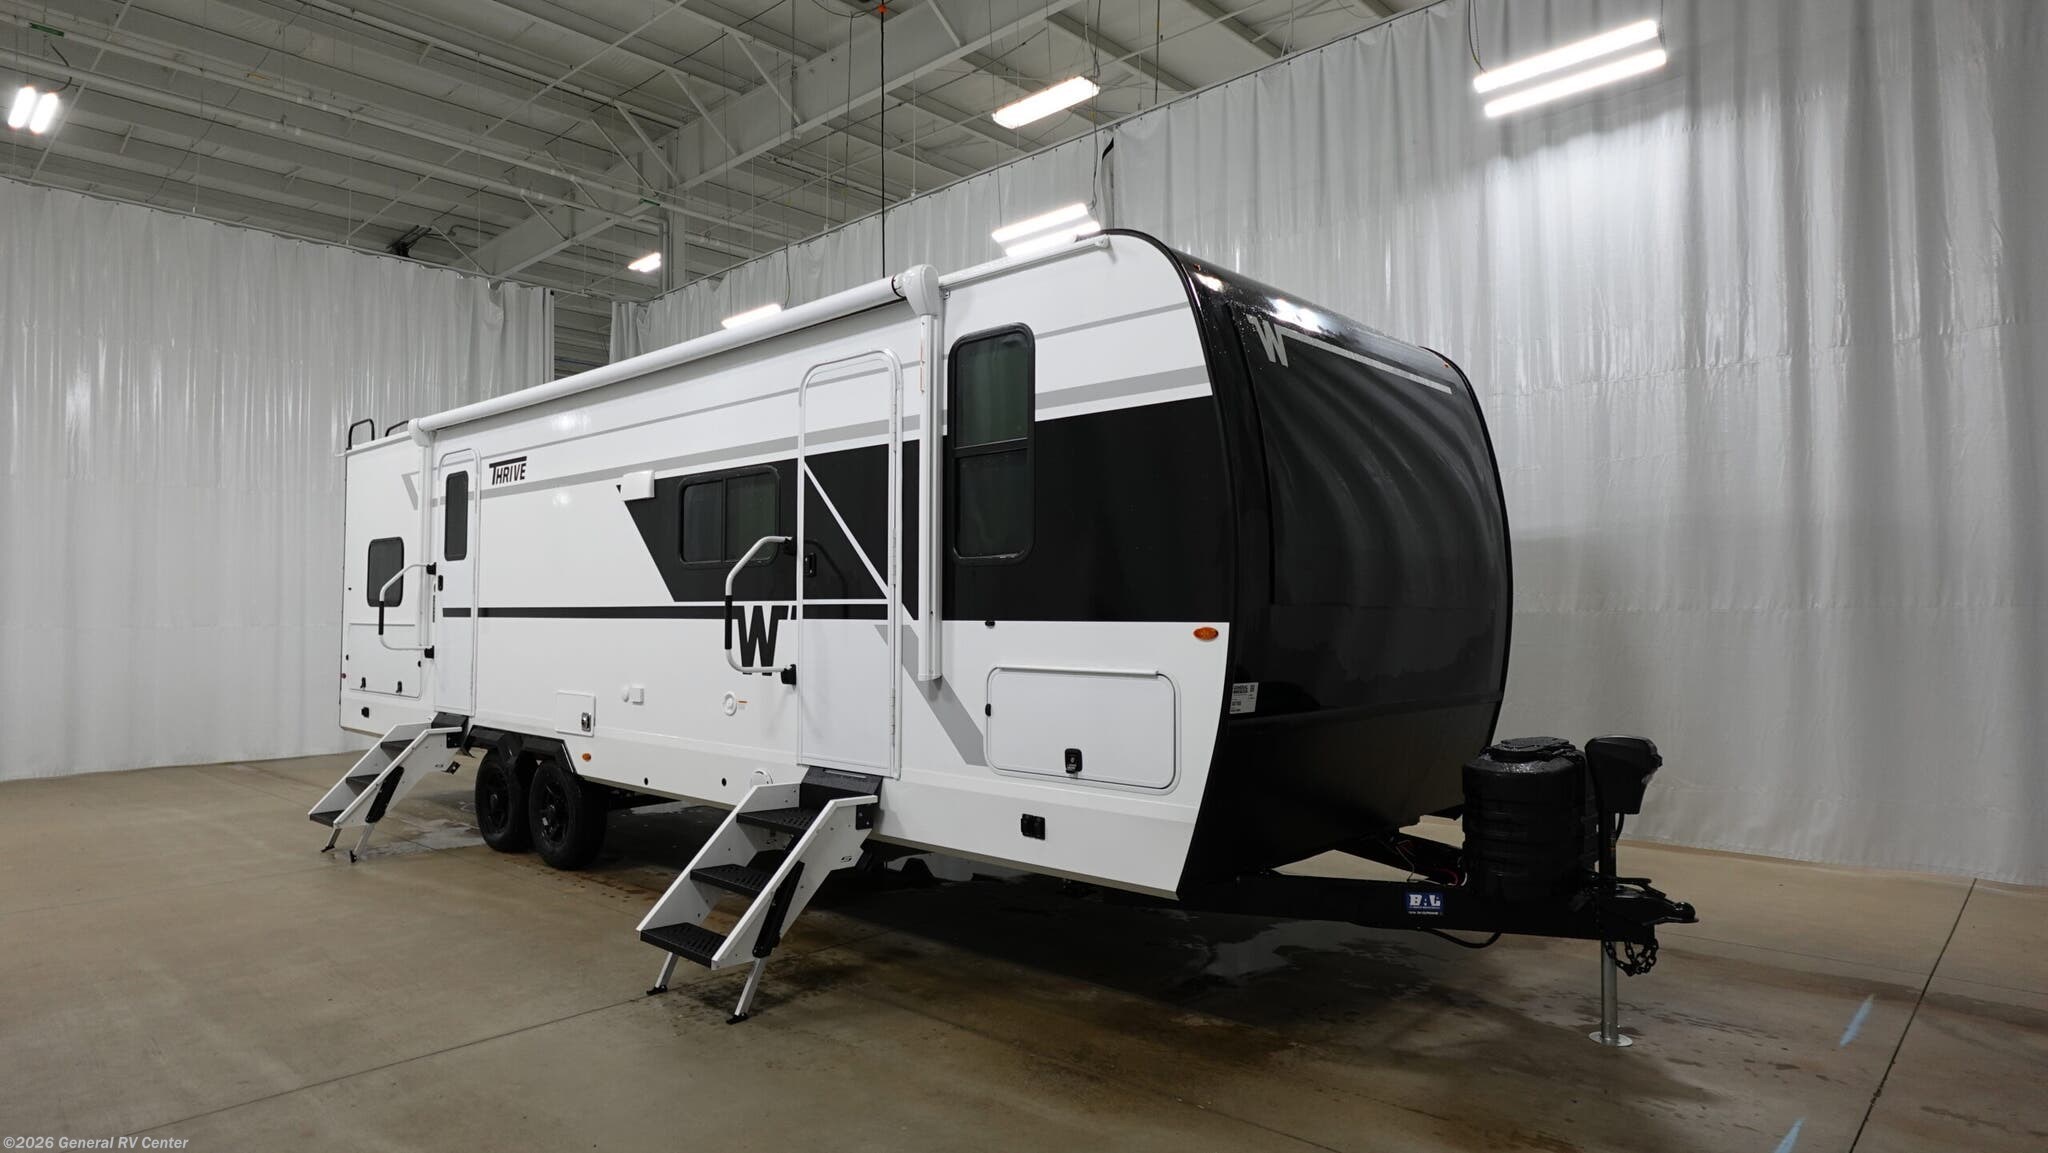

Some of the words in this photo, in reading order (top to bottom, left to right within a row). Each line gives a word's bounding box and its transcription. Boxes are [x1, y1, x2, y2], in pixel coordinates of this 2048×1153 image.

[1246, 314, 1289, 368] W
[489, 456, 527, 485] THRIVE
[736, 604, 789, 676] W
